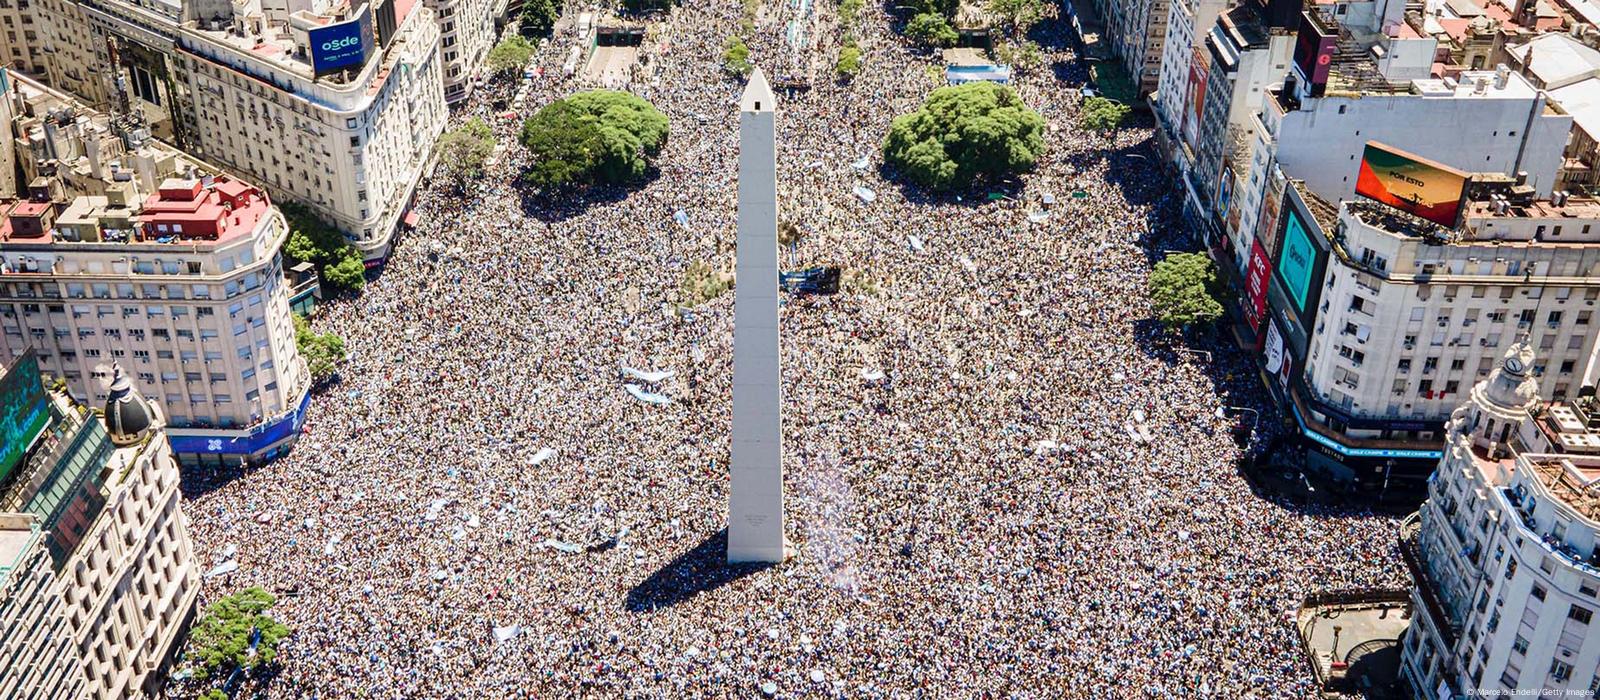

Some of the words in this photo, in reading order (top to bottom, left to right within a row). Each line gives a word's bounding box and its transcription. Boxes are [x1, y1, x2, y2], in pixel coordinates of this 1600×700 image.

[322, 36, 359, 51] osde
[1389, 170, 1405, 181] POR
[1406, 177, 1425, 188] ESTO
[1254, 252, 1266, 276] KFC
